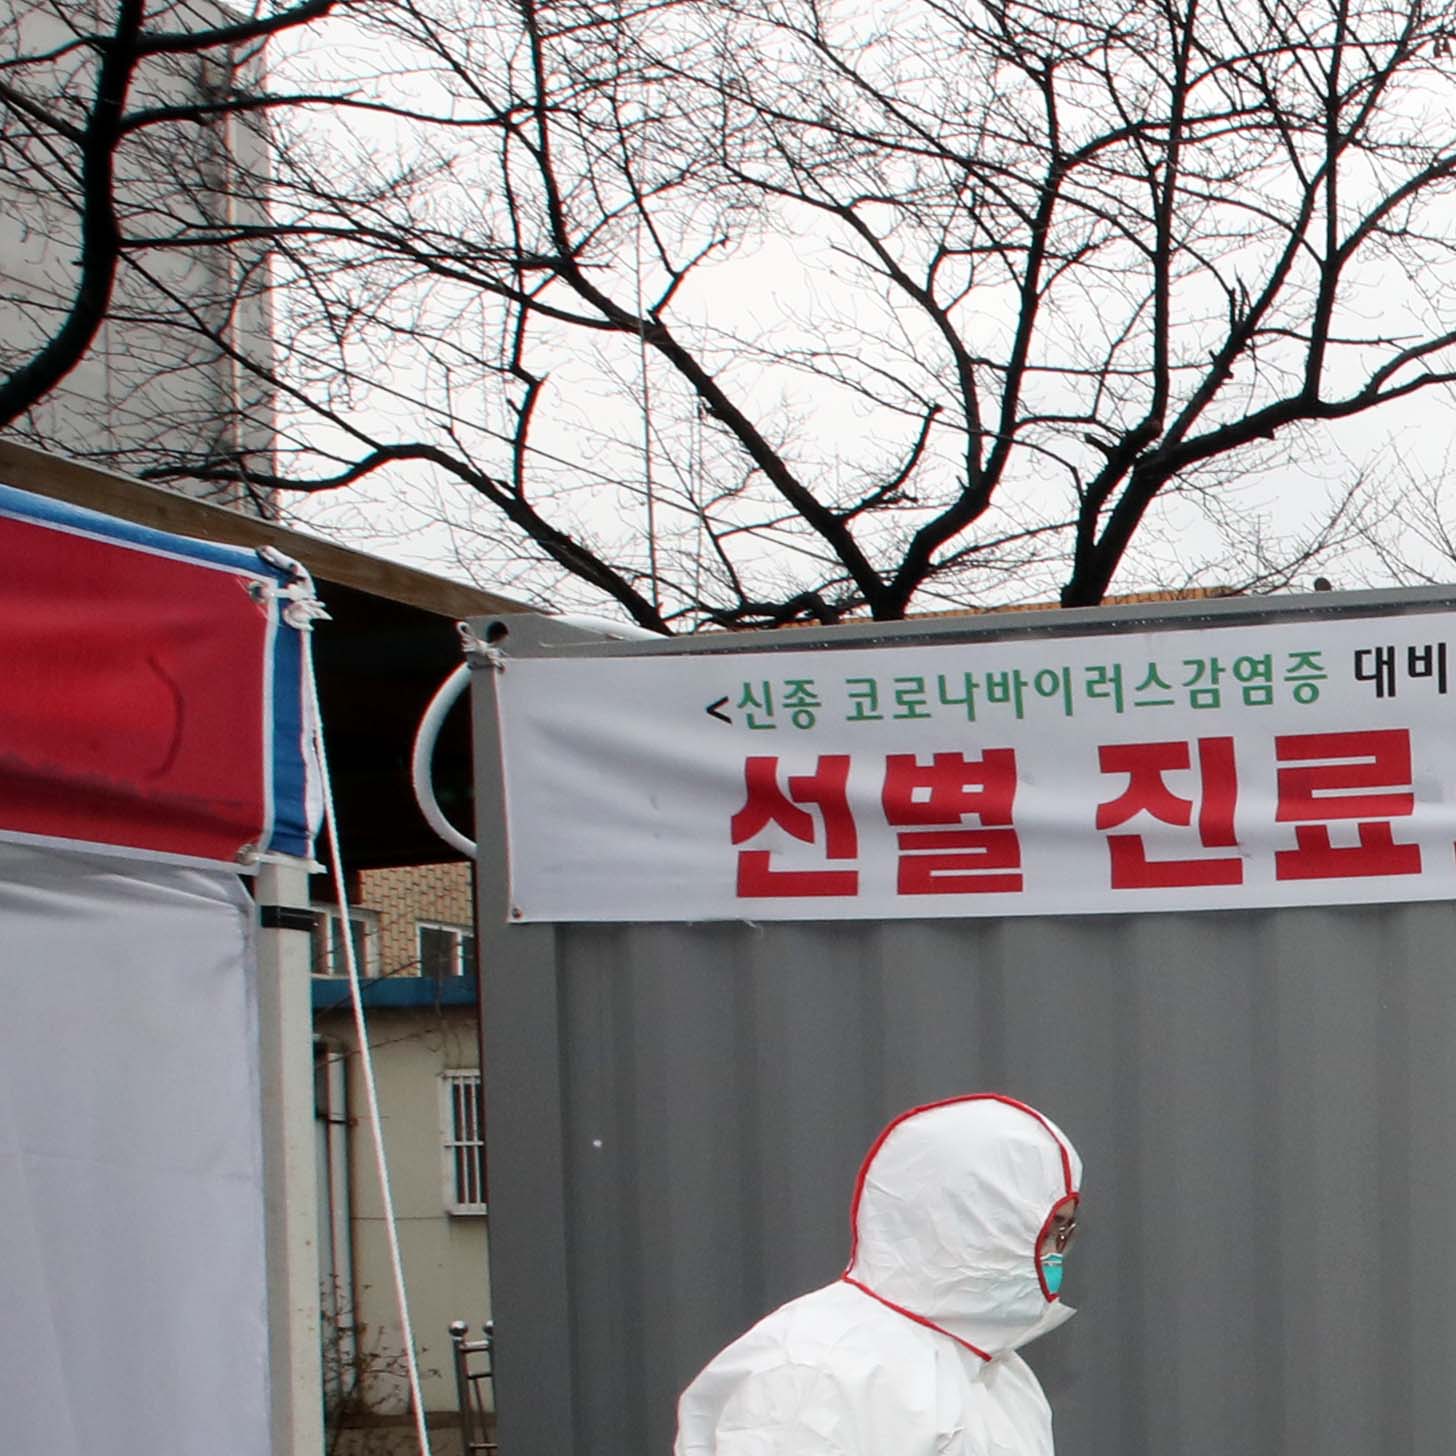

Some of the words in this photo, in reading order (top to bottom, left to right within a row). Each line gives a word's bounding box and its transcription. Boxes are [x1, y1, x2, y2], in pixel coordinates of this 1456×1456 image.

[706, 678, 822, 730] <신종
[845, 650, 1328, 722] 코로나바이러스감염증
[1354, 642, 1447, 698] 대비
[730, 747, 1023, 897] 선별
